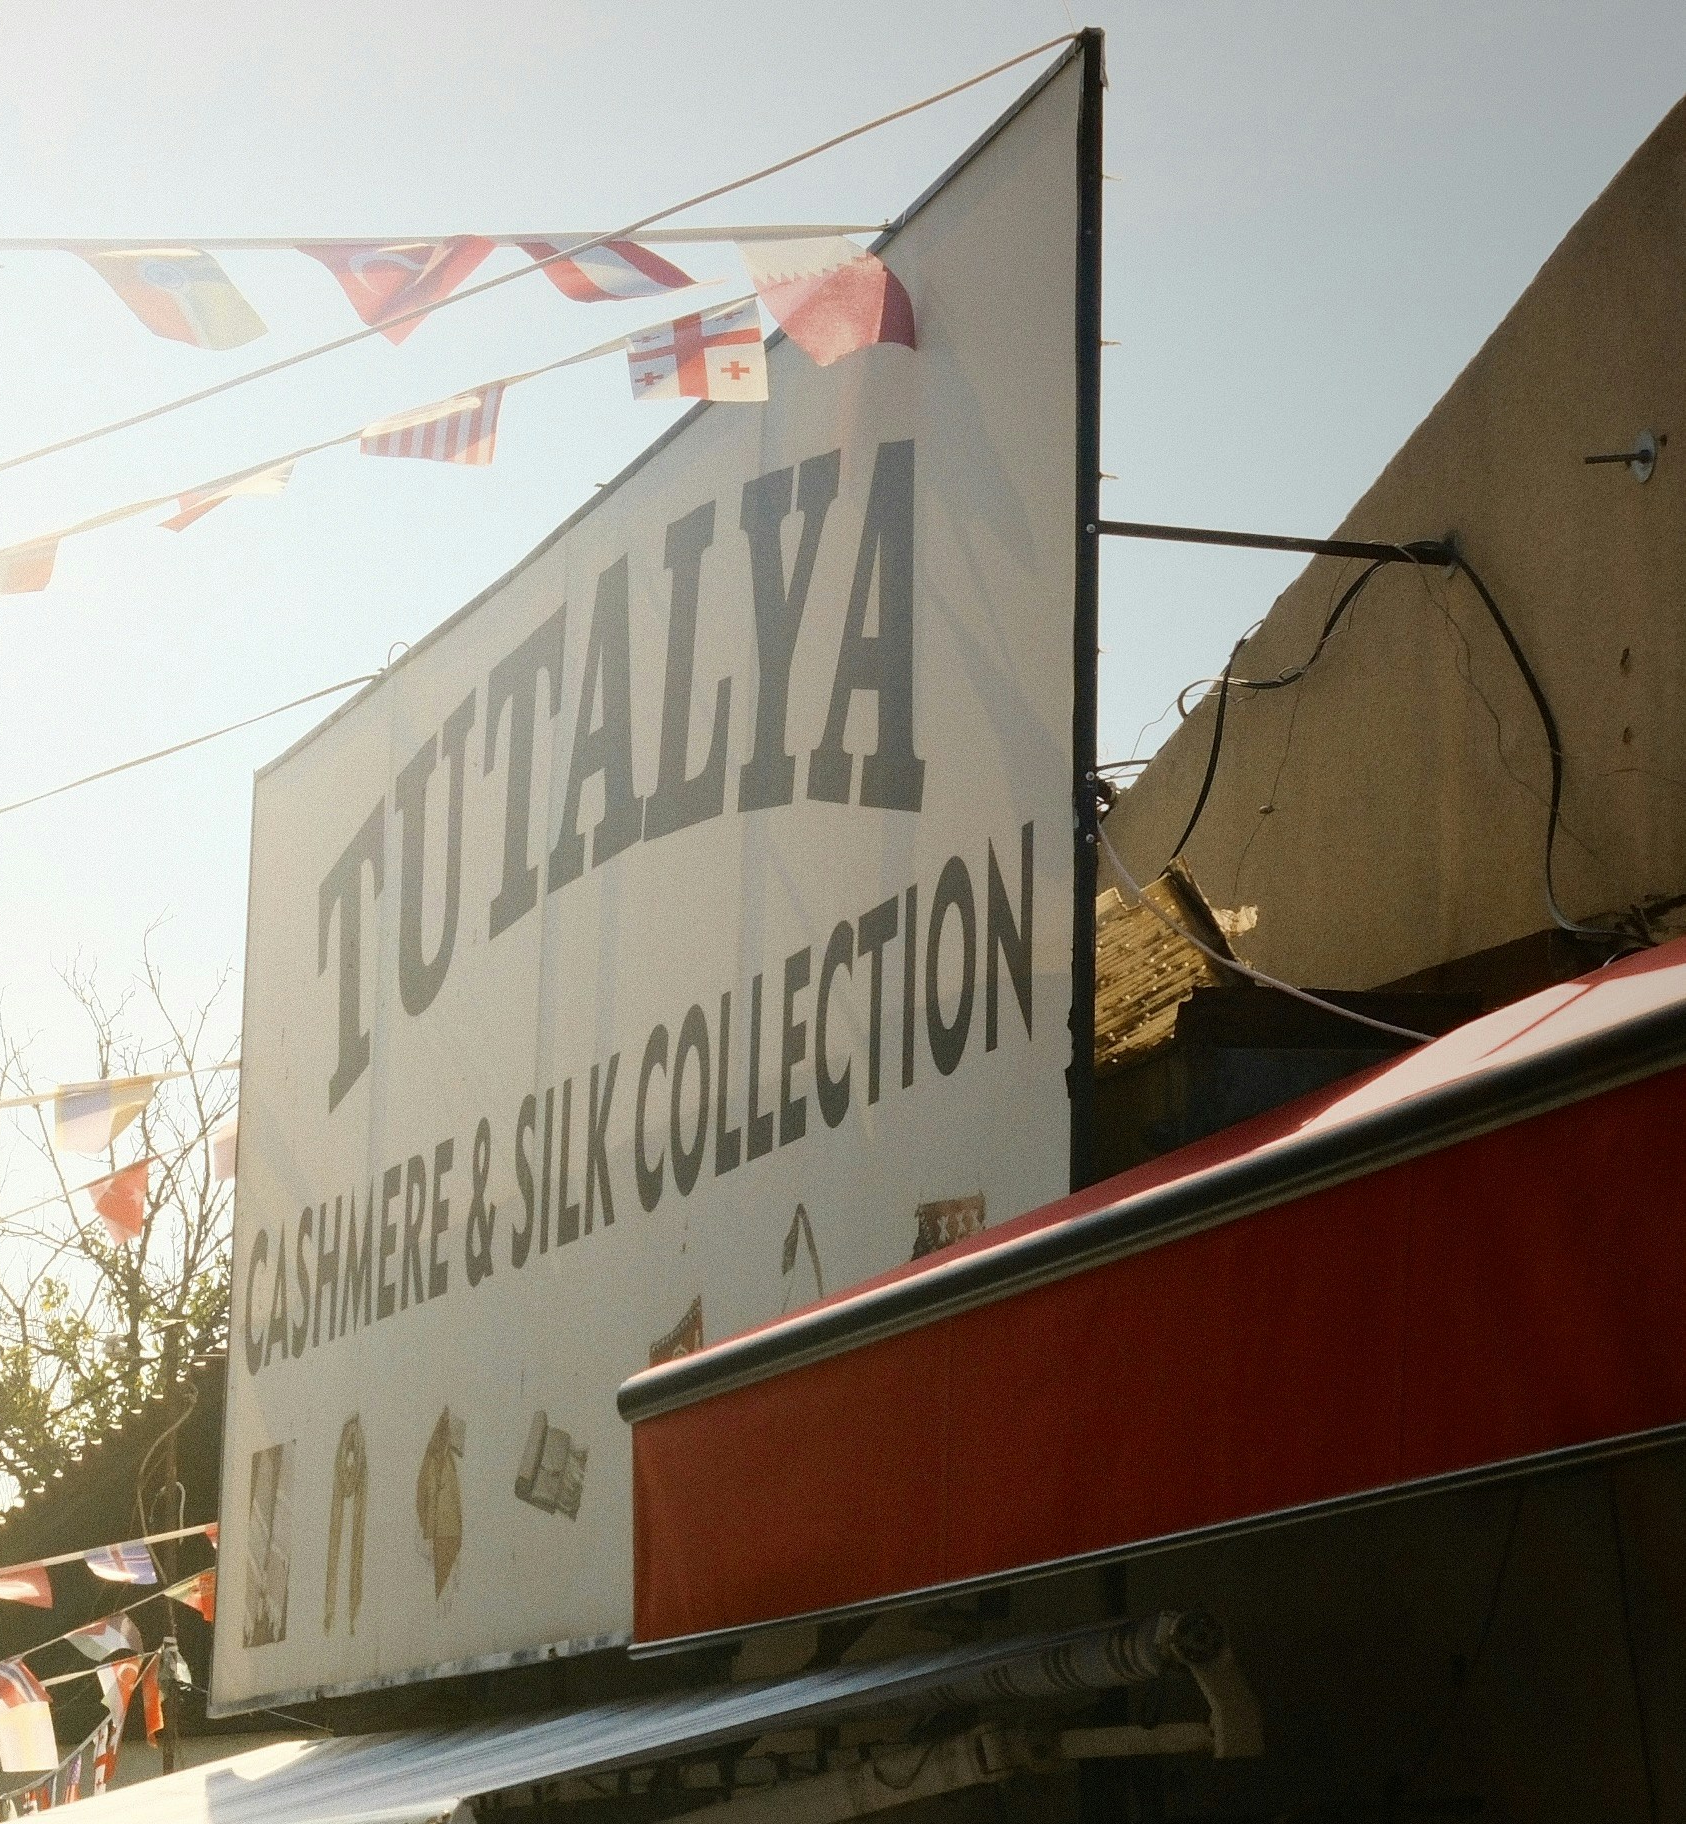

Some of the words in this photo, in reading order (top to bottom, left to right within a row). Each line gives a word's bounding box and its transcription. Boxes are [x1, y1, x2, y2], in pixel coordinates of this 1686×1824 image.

[318, 438, 925, 1114] TUTALYA
[244, 1137, 455, 1376] CASHMERE
[465, 1116, 497, 1289] &
[511, 1052, 622, 1270] SILK
[635, 820, 1034, 1213] COLLECTION
